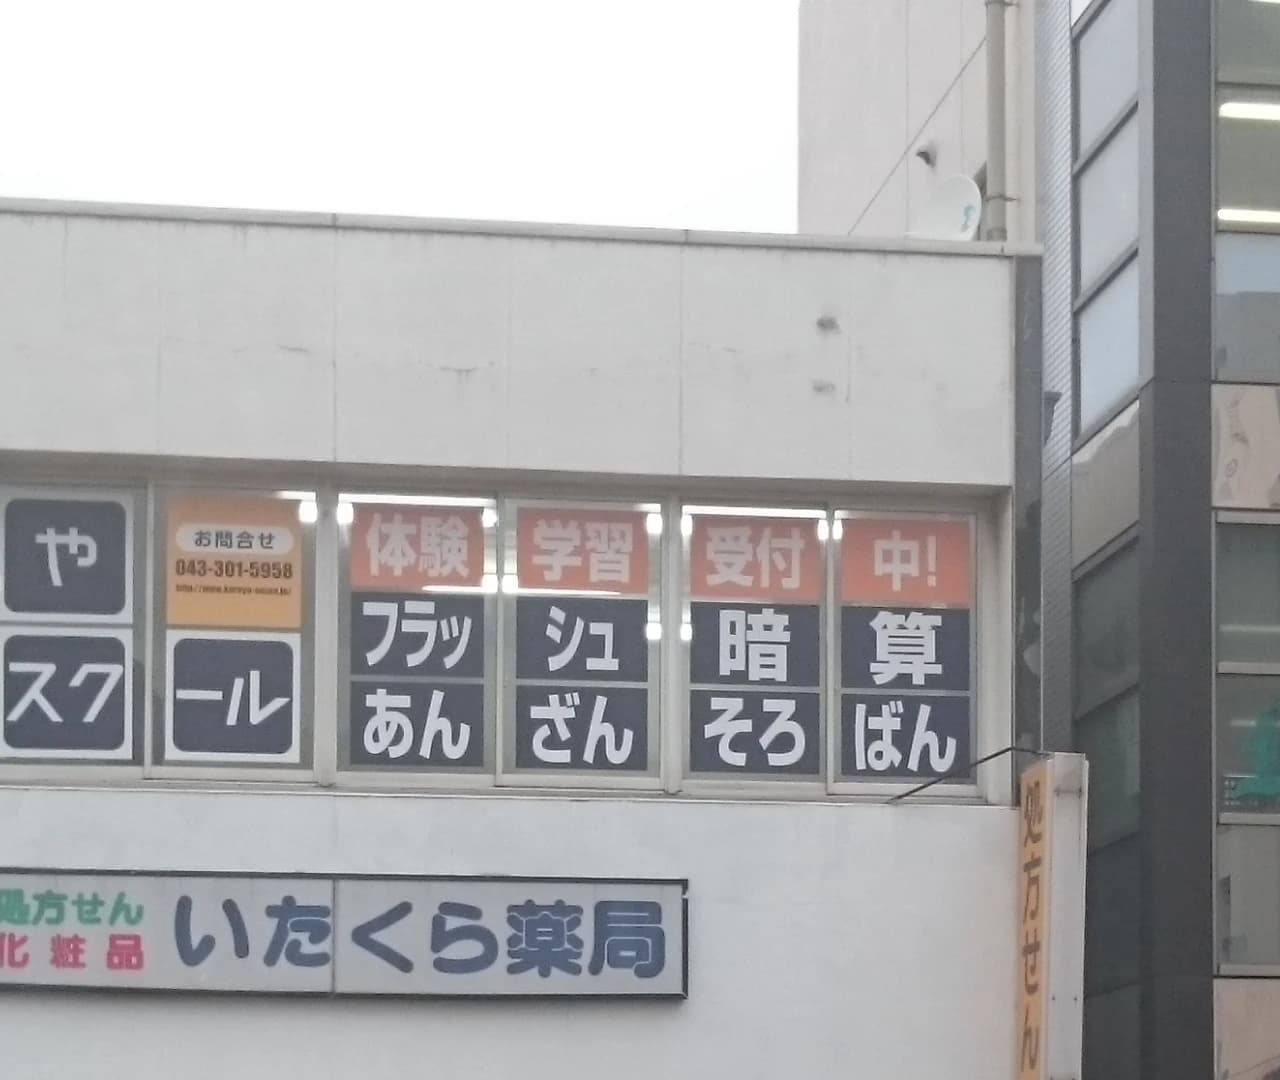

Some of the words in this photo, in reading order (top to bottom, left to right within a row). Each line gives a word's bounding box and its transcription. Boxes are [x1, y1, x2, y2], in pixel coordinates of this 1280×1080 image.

[194, 530, 275, 549] お問合せ
[175, 559, 293, 579] 043-301-5958
[174, 894, 665, 979] いたくら薬局
